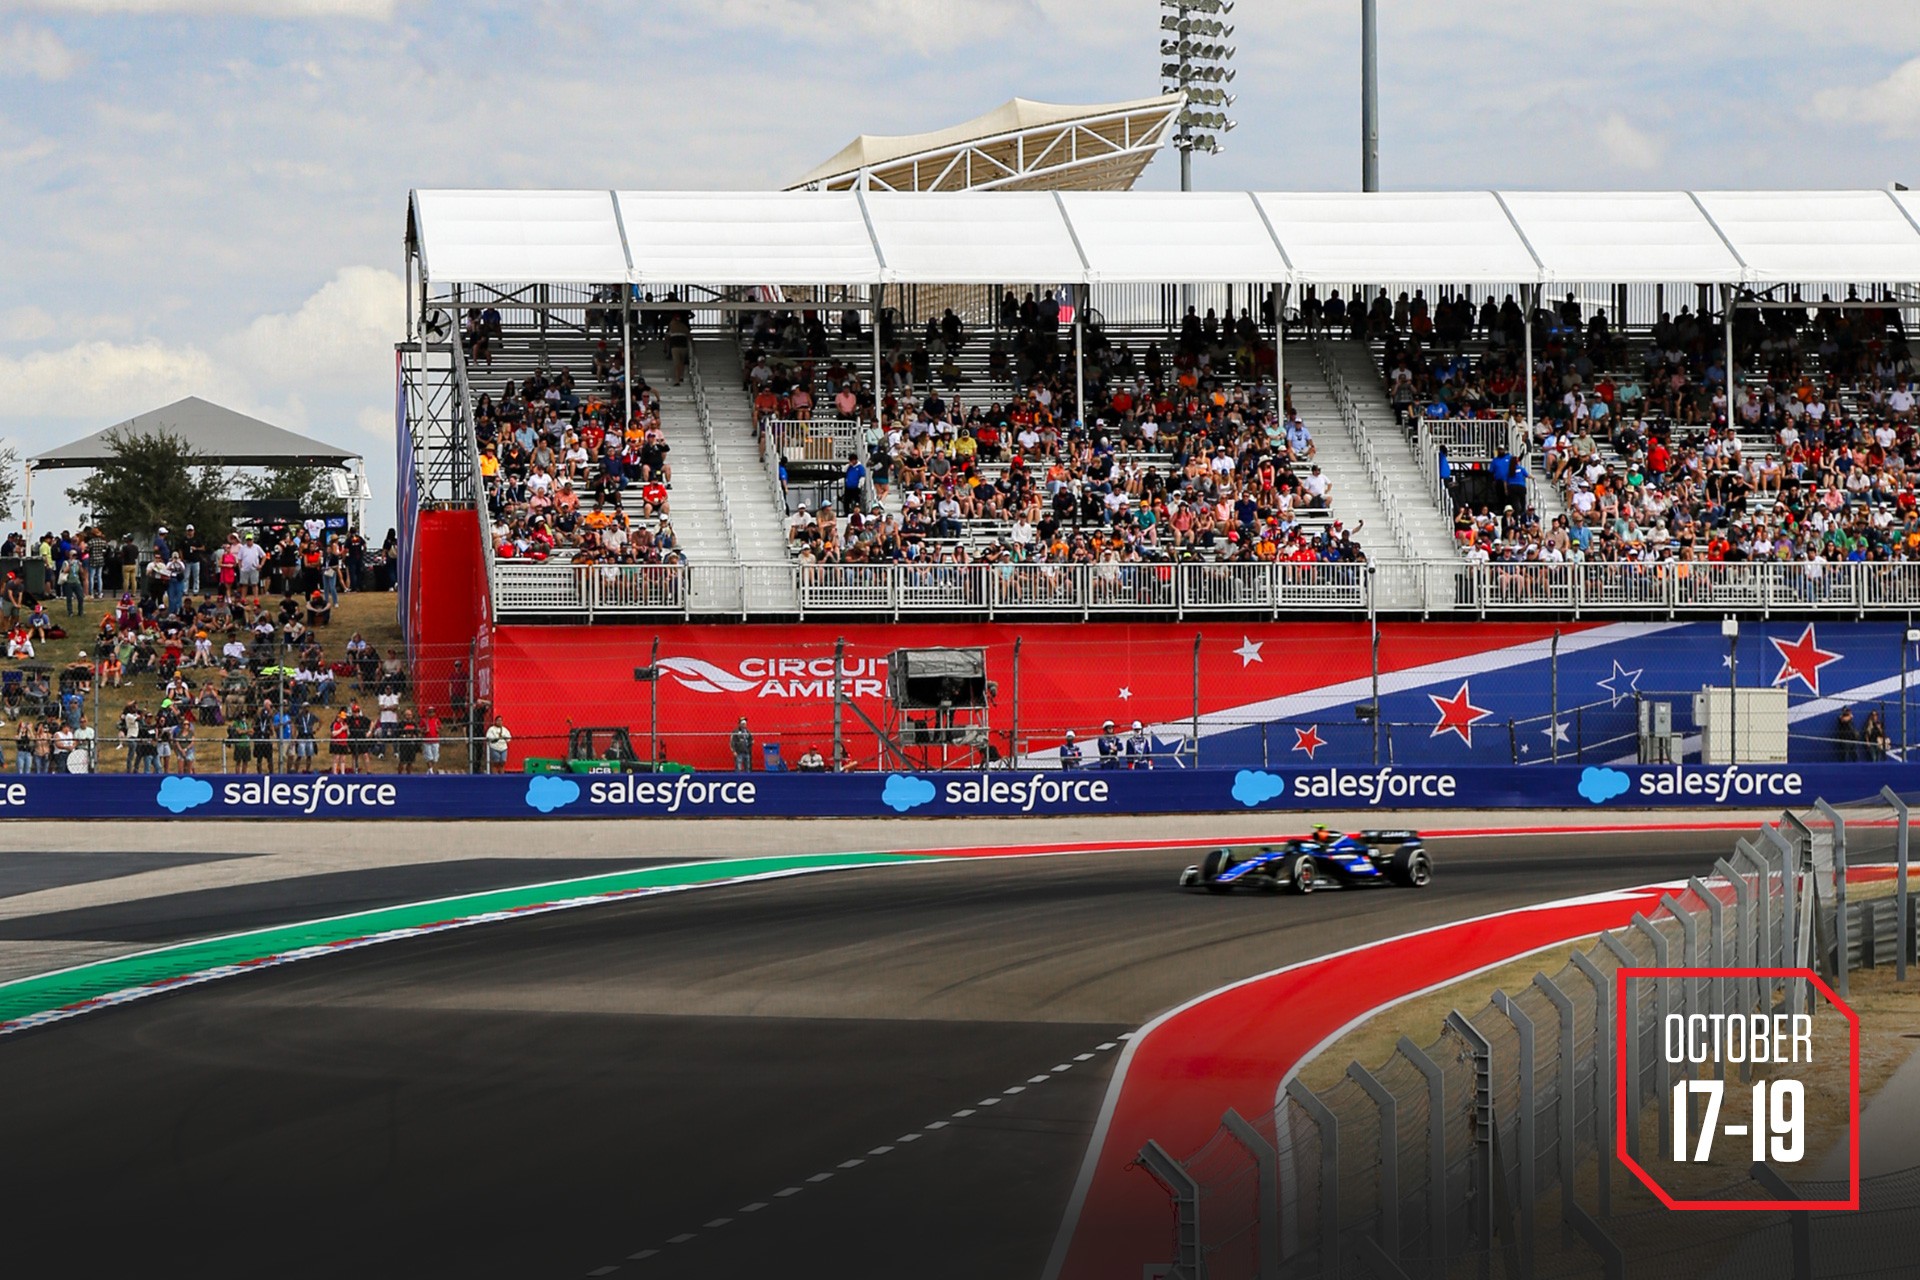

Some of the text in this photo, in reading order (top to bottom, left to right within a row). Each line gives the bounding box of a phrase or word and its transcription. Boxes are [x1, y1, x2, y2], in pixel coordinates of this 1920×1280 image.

[223, 775, 396, 813] salesforce
[590, 775, 756, 811] salesforce
[945, 773, 1109, 810] salesforce
[1294, 767, 1456, 804] salesforce
[1639, 766, 1802, 802] salesforce
